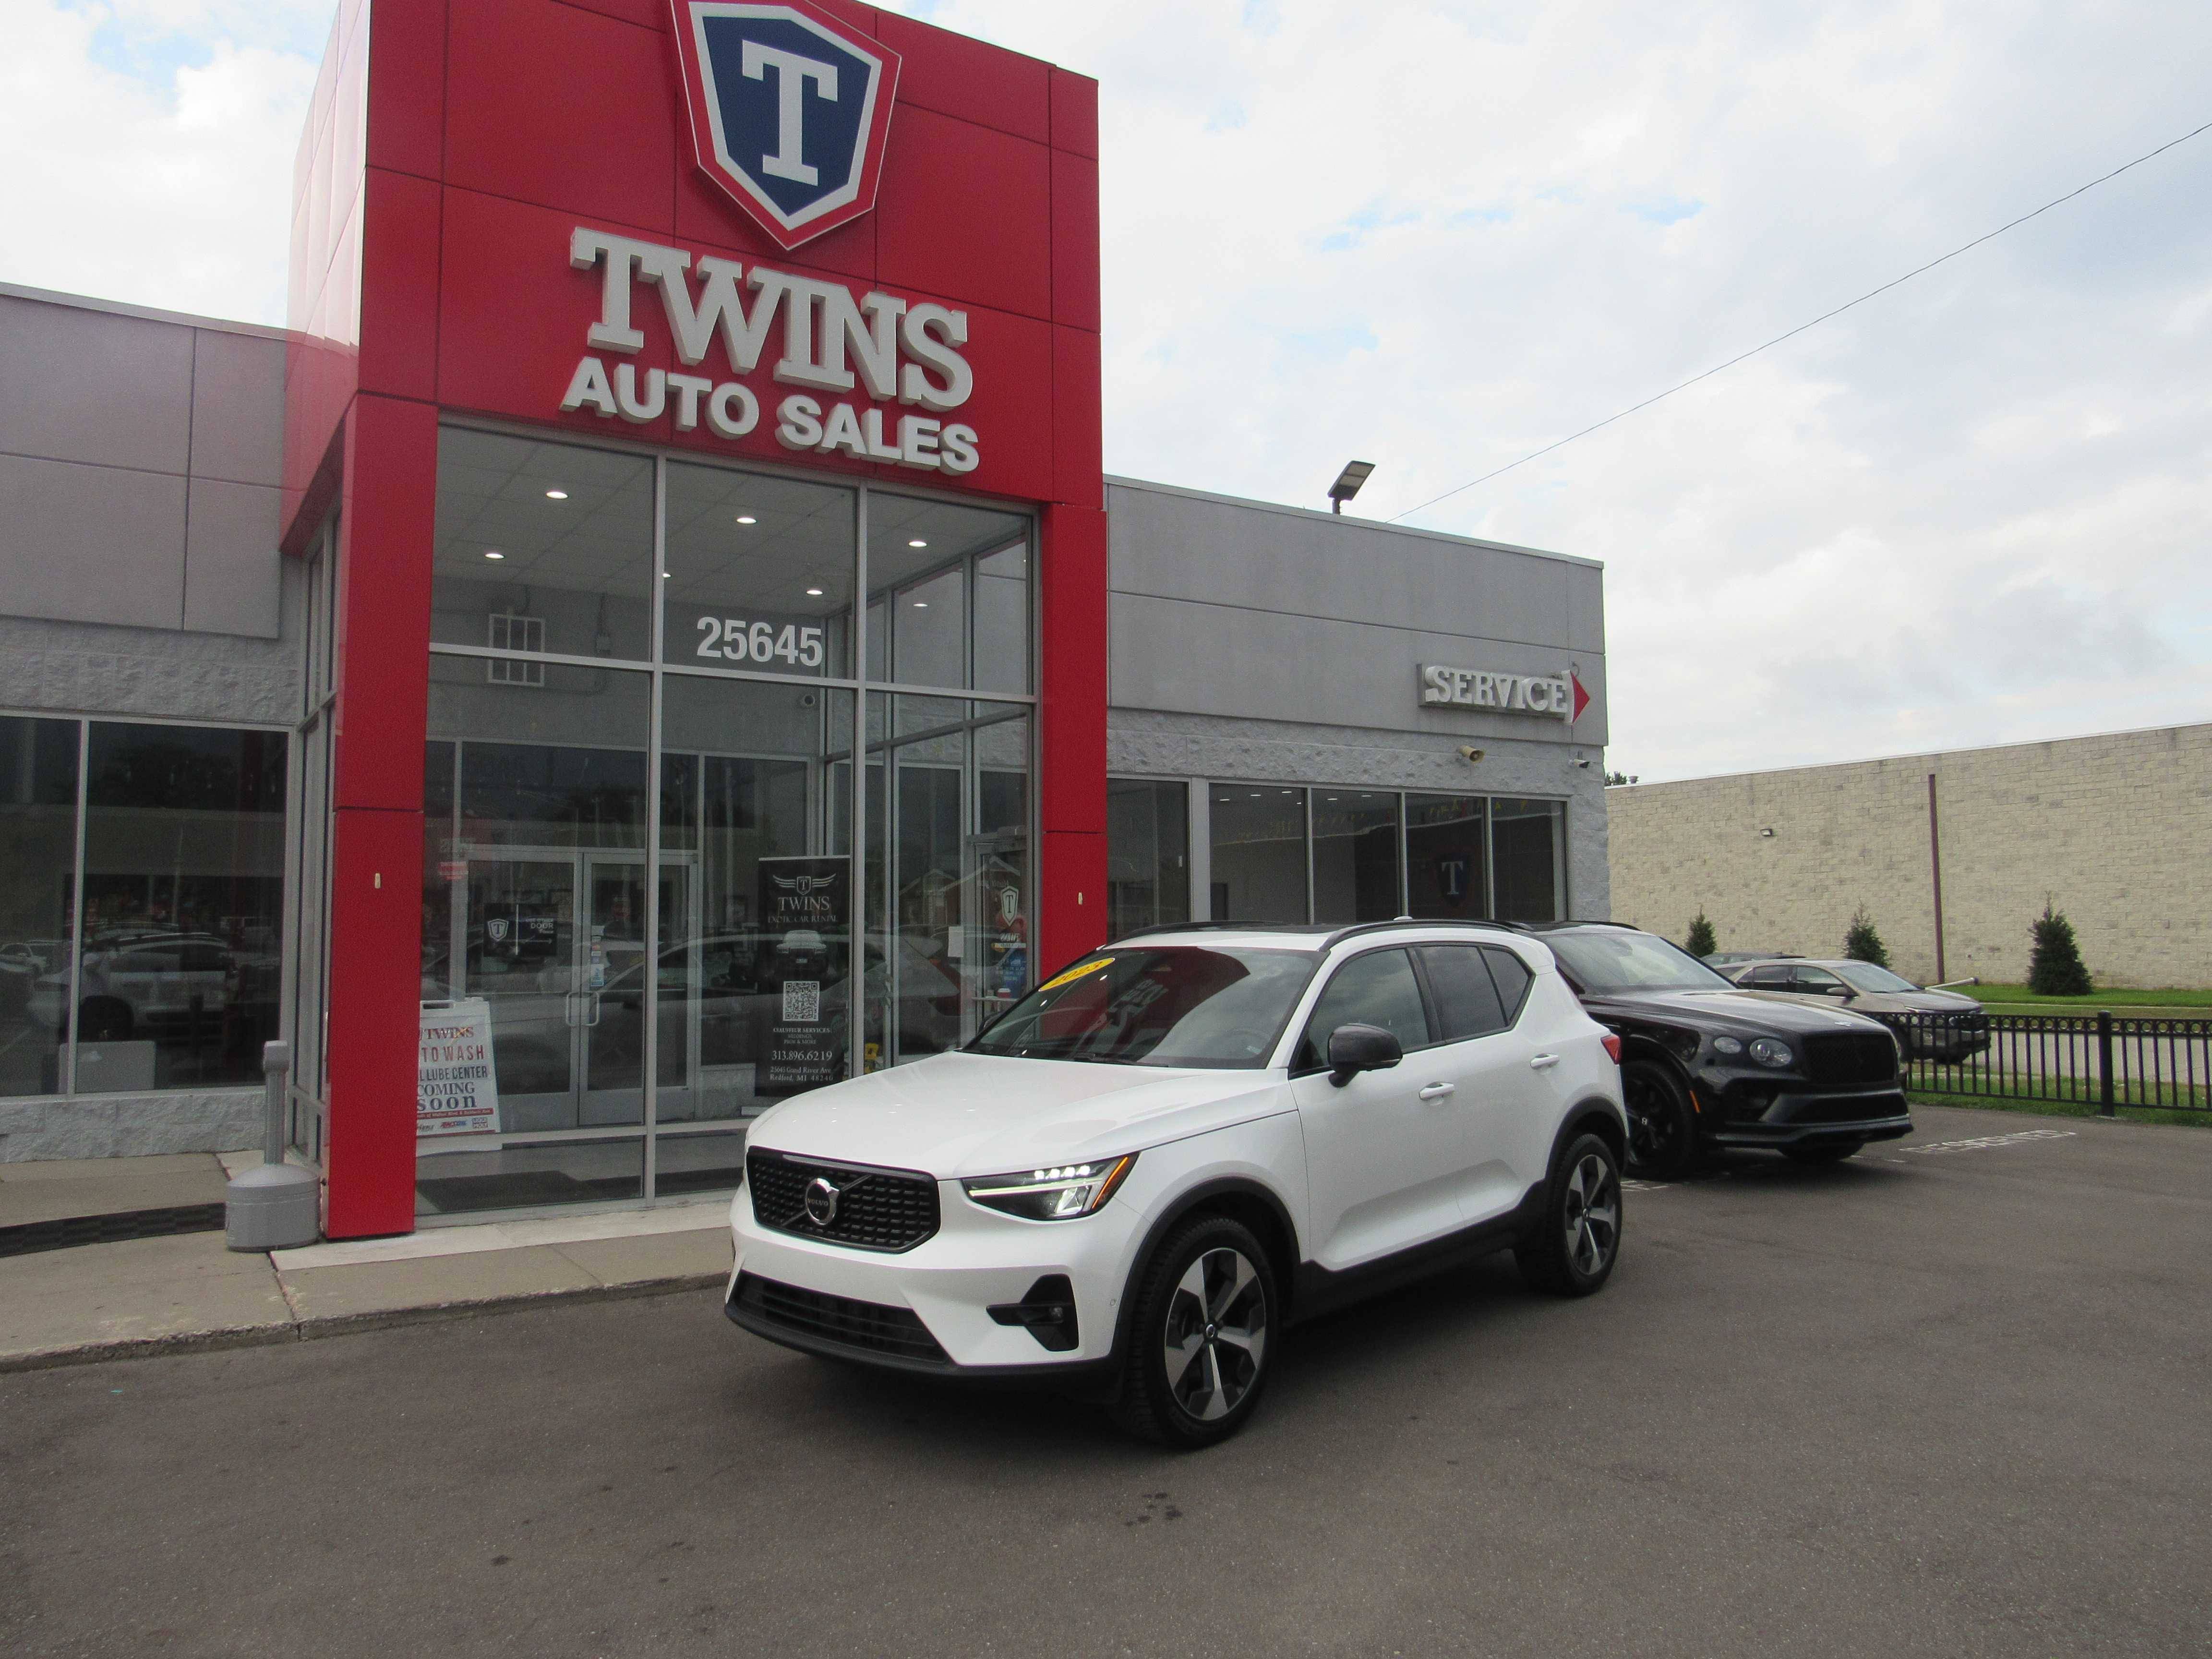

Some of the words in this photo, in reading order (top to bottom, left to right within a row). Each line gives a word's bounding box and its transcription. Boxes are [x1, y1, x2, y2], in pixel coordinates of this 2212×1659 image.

[742, 39, 838, 186] T
[570, 227, 973, 413] TWINS
[559, 356, 760, 440] AUTO
[775, 395, 980, 476] SALES
[697, 617, 823, 667] 25645
[1424, 665, 1568, 713] SERVICE
[1441, 861, 1464, 895] T
[778, 896, 830, 911] TWINS
[1006, 895, 1014, 914] T
[425, 1027, 474, 1039] TWINS
[443, 1044, 484, 1061] WASH
[771, 1050, 833, 1060] 313.896.6219
[427, 1068, 450, 1081] LUBE
[452, 1065, 488, 1079] CENTER
[417, 1082, 475, 1097] COMING
[807, 1198, 829, 1206] VOLVO
